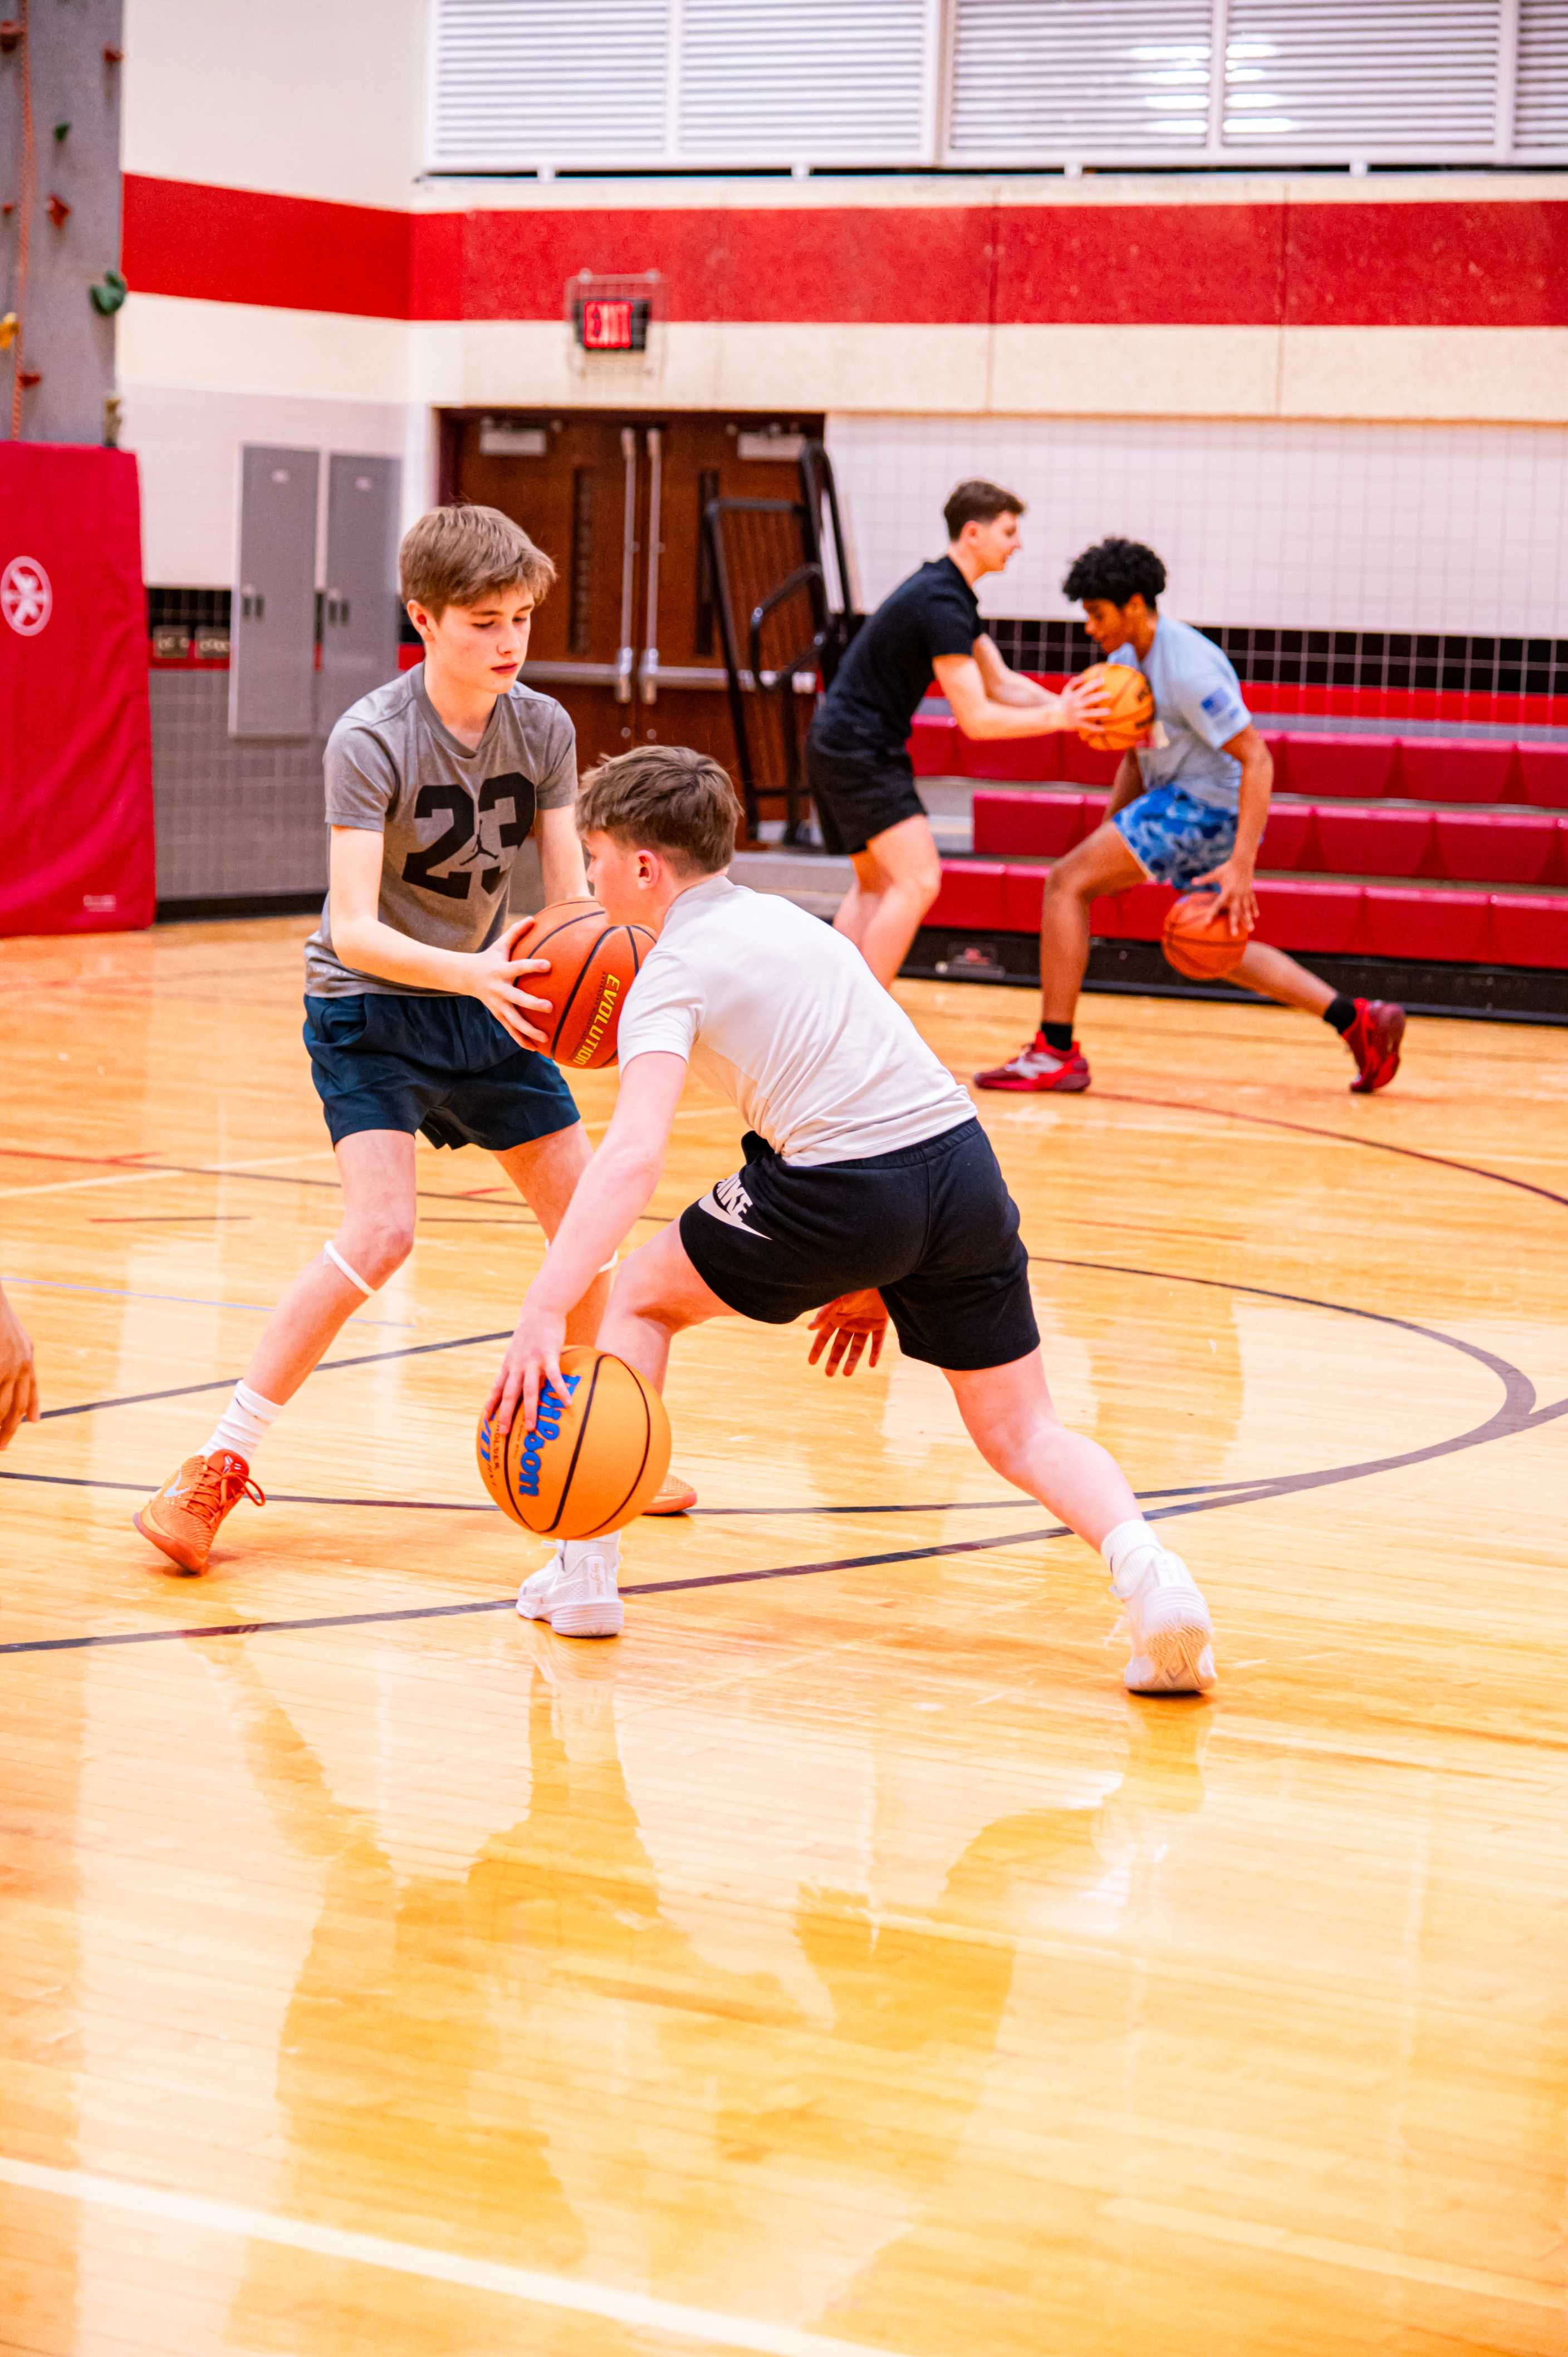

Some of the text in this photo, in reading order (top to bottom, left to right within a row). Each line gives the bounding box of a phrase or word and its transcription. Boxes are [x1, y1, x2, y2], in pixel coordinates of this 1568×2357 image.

[401, 772, 535, 900] 23
[573, 974, 620, 1066] EVOLUTION
[518, 1373, 582, 1497] Wilson
